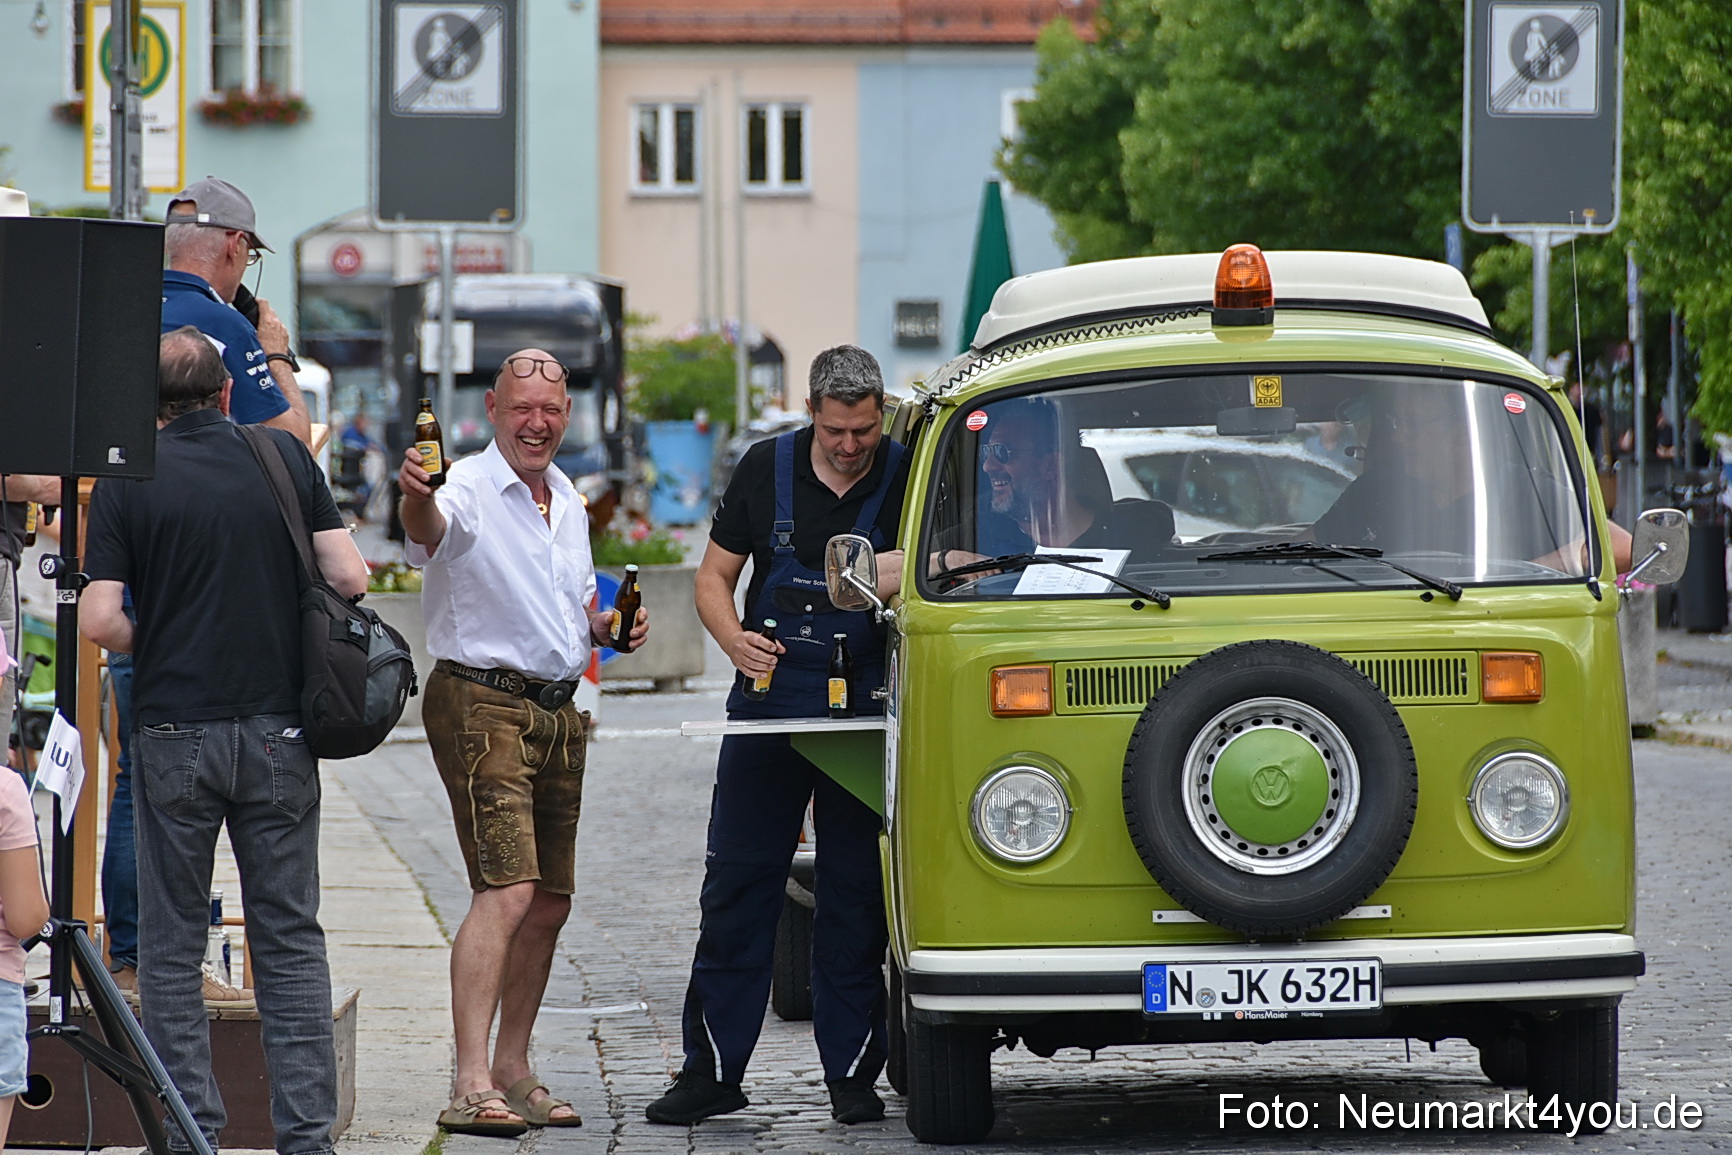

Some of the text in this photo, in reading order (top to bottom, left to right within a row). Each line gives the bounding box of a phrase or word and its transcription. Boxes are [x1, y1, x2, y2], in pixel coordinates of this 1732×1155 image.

[1516, 87, 1570, 108] ZONE
[1258, 397, 1279, 405] ADAC
[792, 576, 812, 586] Werner
[1169, 966, 1377, 1006] N JK 632H
[1151, 993, 1161, 1004] D
